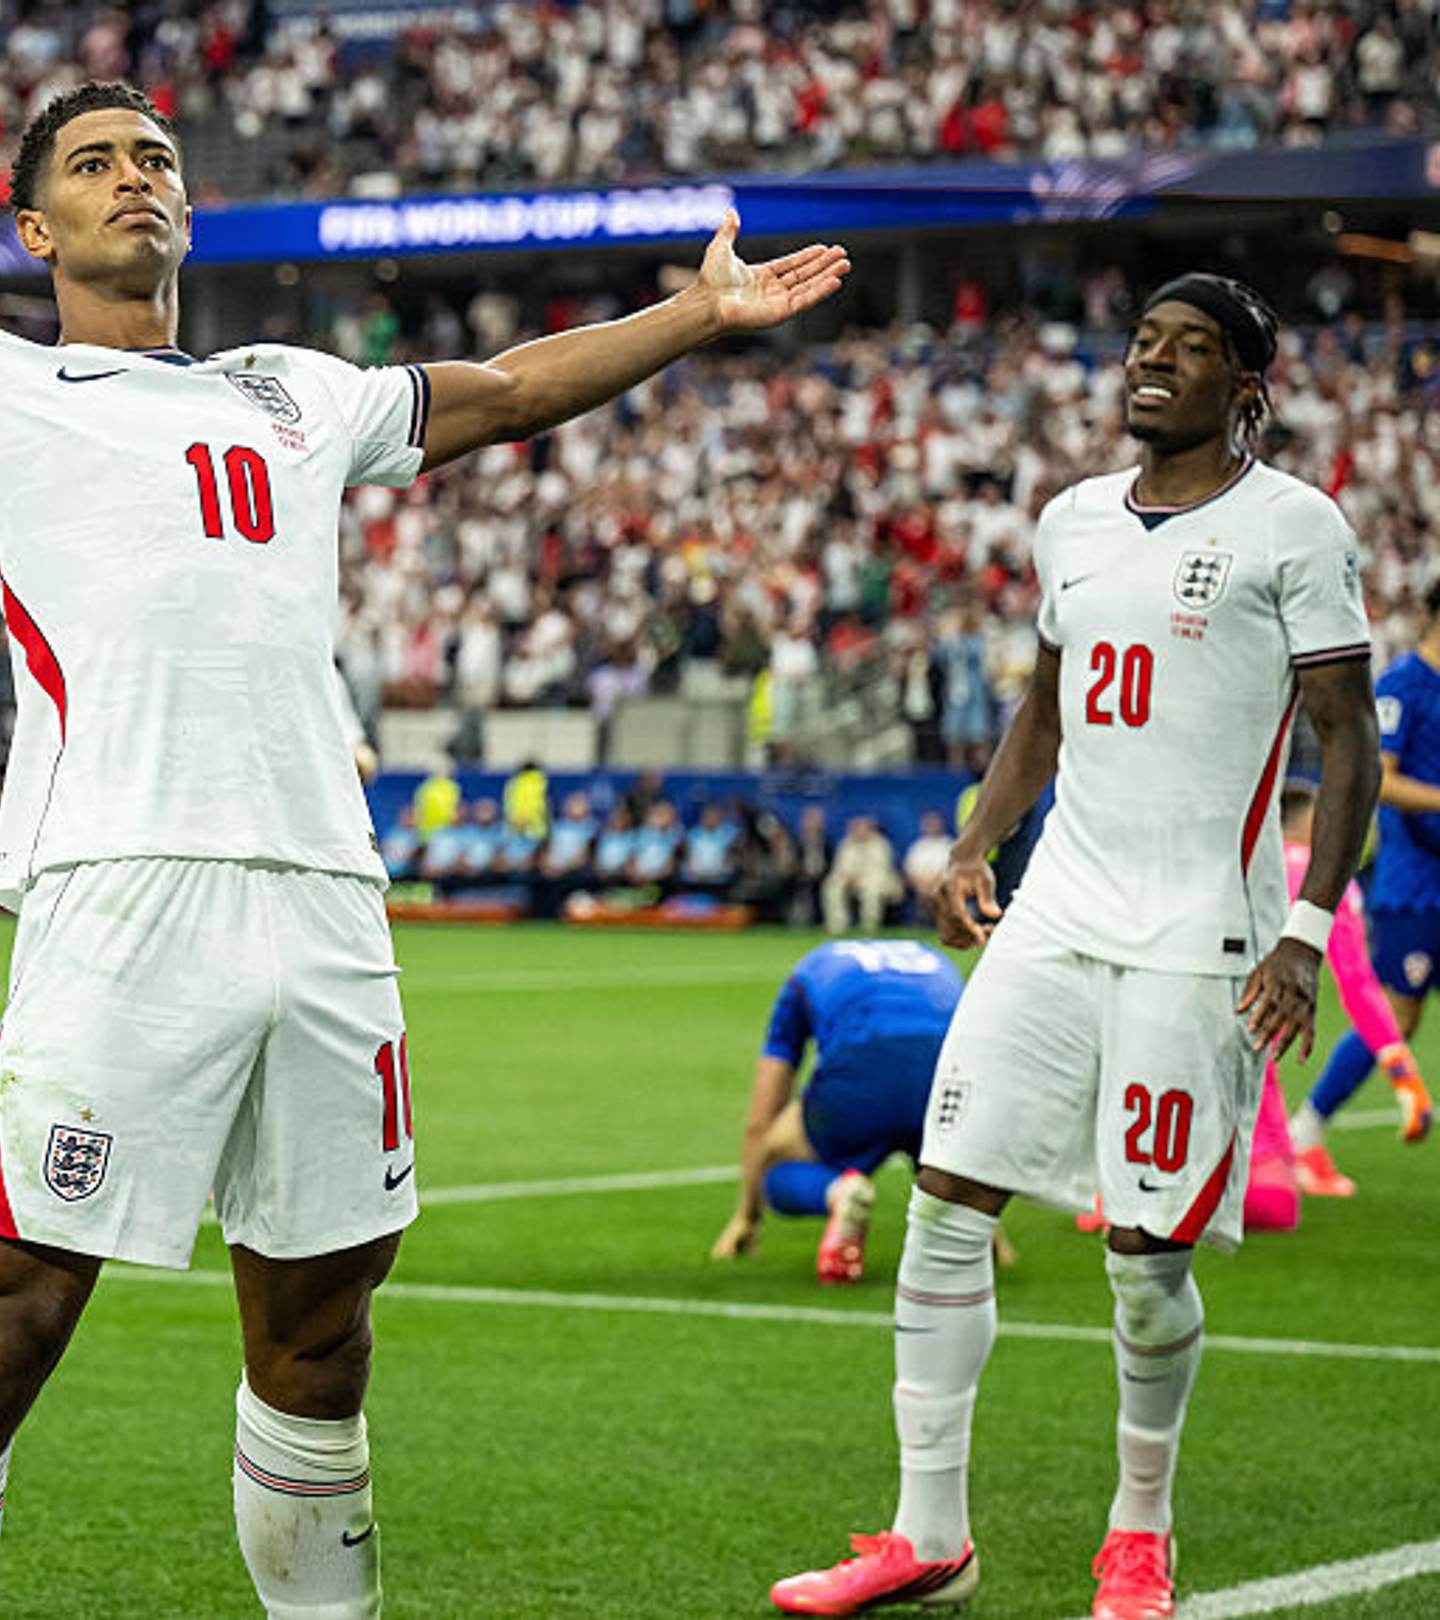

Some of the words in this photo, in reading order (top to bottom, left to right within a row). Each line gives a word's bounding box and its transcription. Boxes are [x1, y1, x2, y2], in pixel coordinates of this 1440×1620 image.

[185, 442, 276, 544] 10
[1086, 641, 1154, 728] 20
[1124, 1082, 1194, 1174] 20
